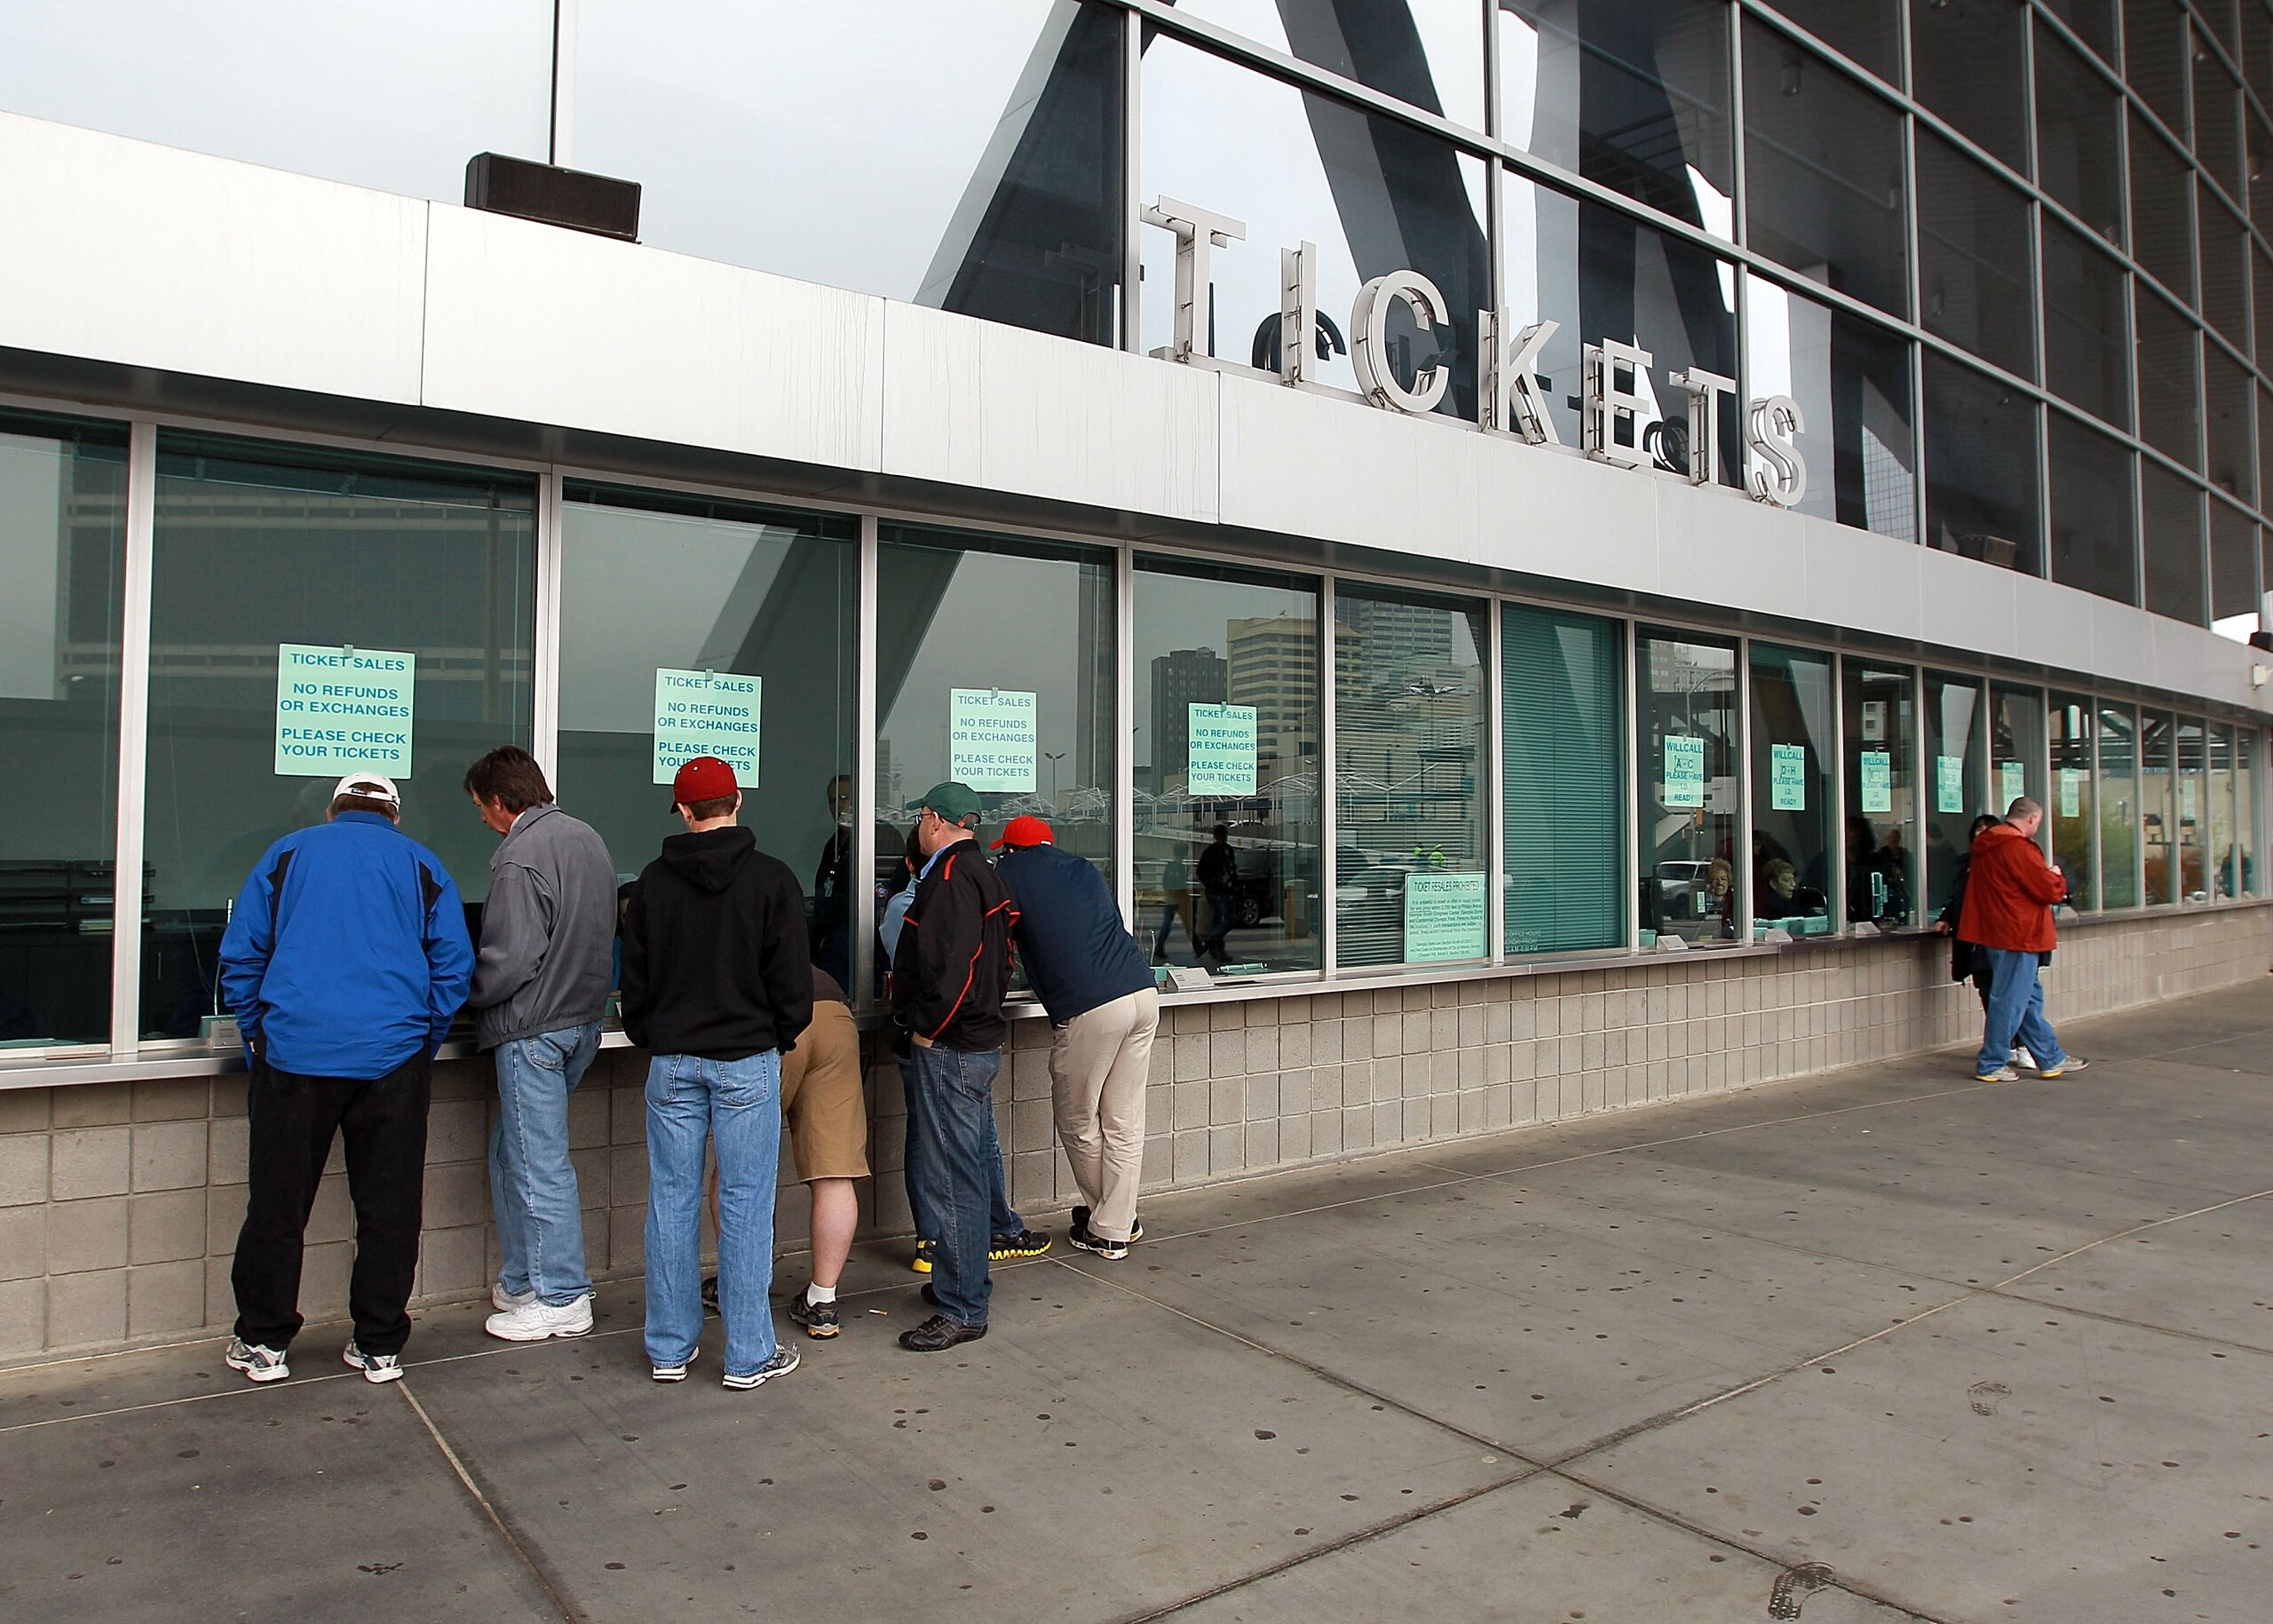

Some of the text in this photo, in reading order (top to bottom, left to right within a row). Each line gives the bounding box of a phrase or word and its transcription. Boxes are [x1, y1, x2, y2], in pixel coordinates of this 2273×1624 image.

[1144, 194, 1807, 506] TICKETS
[290, 653, 405, 671] TICKET SALES
[293, 683, 398, 700] NO REFUNDS
[665, 676, 754, 693] TICKET SALES
[280, 700, 409, 717] OR EXCHANGES
[958, 695, 1030, 707] TICKET SALES
[668, 702, 748, 717] NO REFUNDS
[1226, 711, 1253, 720] SALES
[658, 717, 757, 733] OR EXCHANGES
[978, 718, 1027, 729] REFUNDS
[281, 728, 406, 744] PLEASE CHECK
[953, 732, 1034, 742] OR EXCHANGES
[1210, 729, 1249, 738] REFUNDS
[281, 744, 400, 760] YOUR TICKETS
[659, 742, 756, 757] PLEASE CHECK
[1205, 741, 1255, 750] EXCHANGES
[954, 754, 1034, 764] PLEASE CHECK
[954, 767, 1029, 776] YOUR TICKETS
[1414, 880, 1479, 892] TICKET RESALES PROHIBITED
